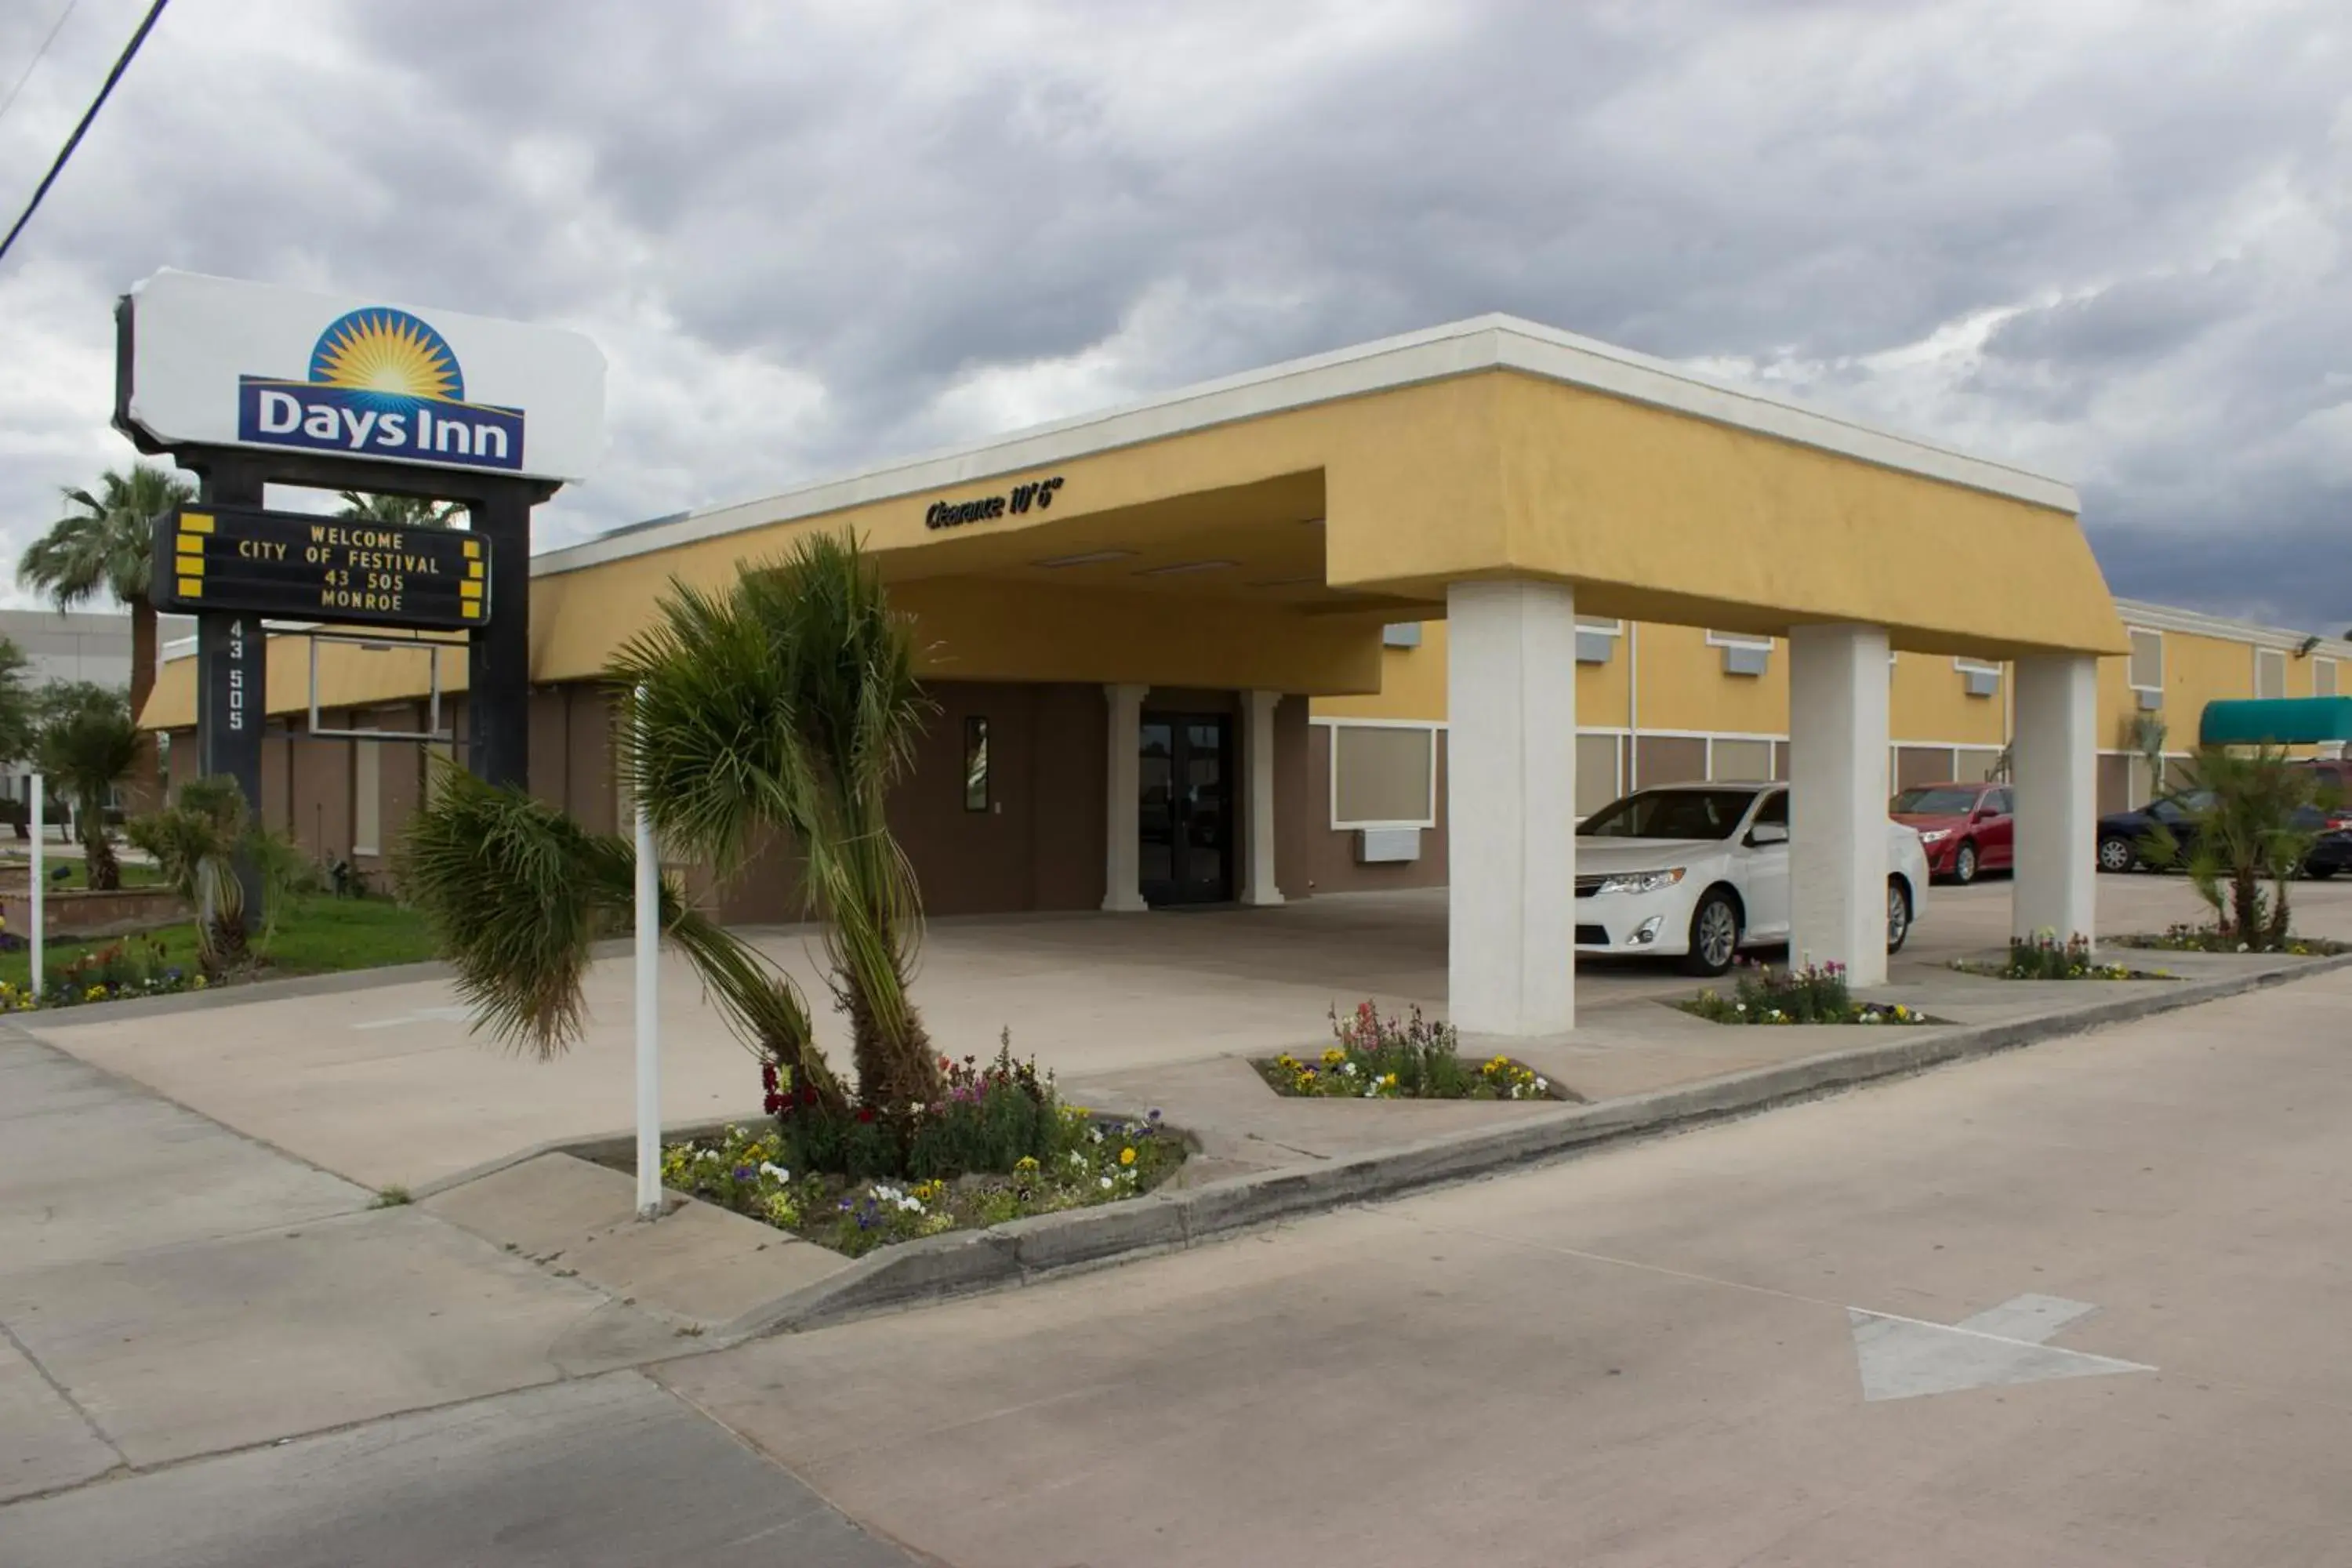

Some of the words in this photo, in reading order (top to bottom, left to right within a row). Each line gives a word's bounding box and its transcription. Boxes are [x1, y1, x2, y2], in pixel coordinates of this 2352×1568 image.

[259, 390, 406, 449] Days
[417, 409, 507, 459] Inn
[925, 495, 1006, 530] Clearance
[310, 525, 403, 550] WELCOME
[239, 539, 287, 561] CITY
[306, 546, 332, 564] OF
[349, 553, 440, 575] FESTIVAL
[324, 569, 349, 586] 43
[321, 590, 402, 612] MONROE
